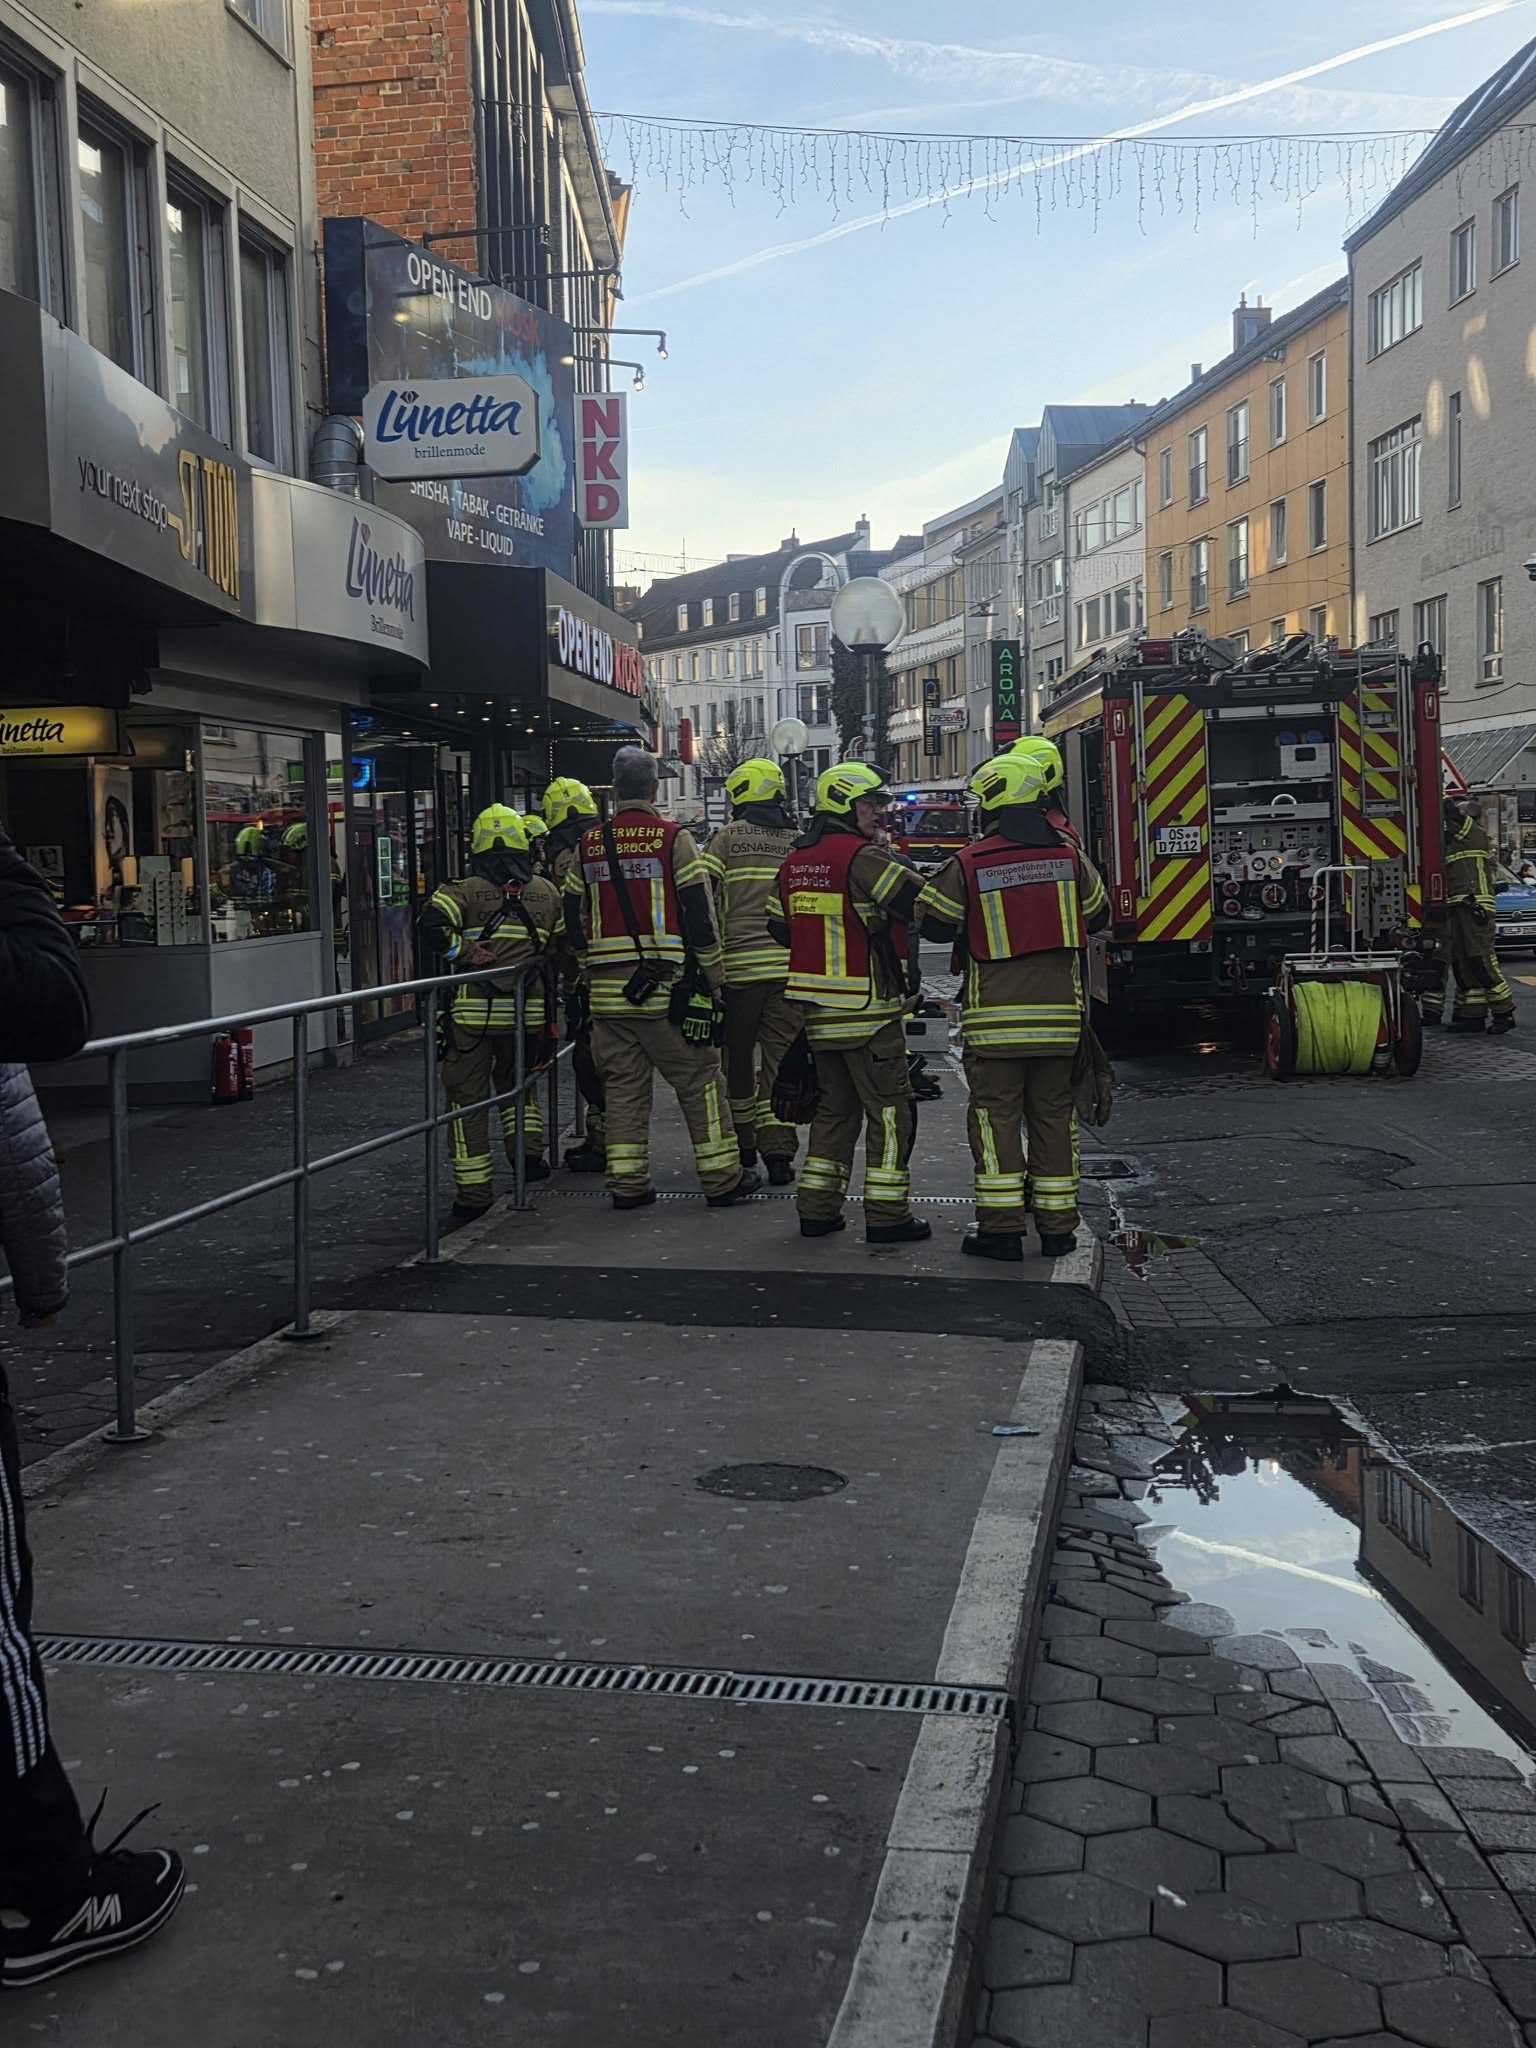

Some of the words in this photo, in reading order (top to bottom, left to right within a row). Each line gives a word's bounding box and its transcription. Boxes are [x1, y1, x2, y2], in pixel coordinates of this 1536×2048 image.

[407, 253, 454, 304] OPEN
[458, 277, 492, 321] END
[414, 444, 486, 459] brillenmode
[582, 399, 621, 522] NKD
[78, 456, 112, 498] your
[114, 477, 141, 515] next
[143, 489, 169, 533] stop
[410, 481, 450, 506] SHISHA
[457, 491, 490, 519] TABAK
[495, 504, 544, 537] GETRÄNKE
[447, 518, 474, 546] VAPE
[481, 530, 514, 557] LIQUID
[558, 607, 591, 676] OPEN
[592, 626, 614, 686] END
[999, 648, 1016, 721] AROMA
[0, 714, 65, 745] netta
[587, 827, 665, 841] FEERWEHR
[587, 842, 653, 857] OSNBRÜCK
[1168, 828, 1184, 840] OS
